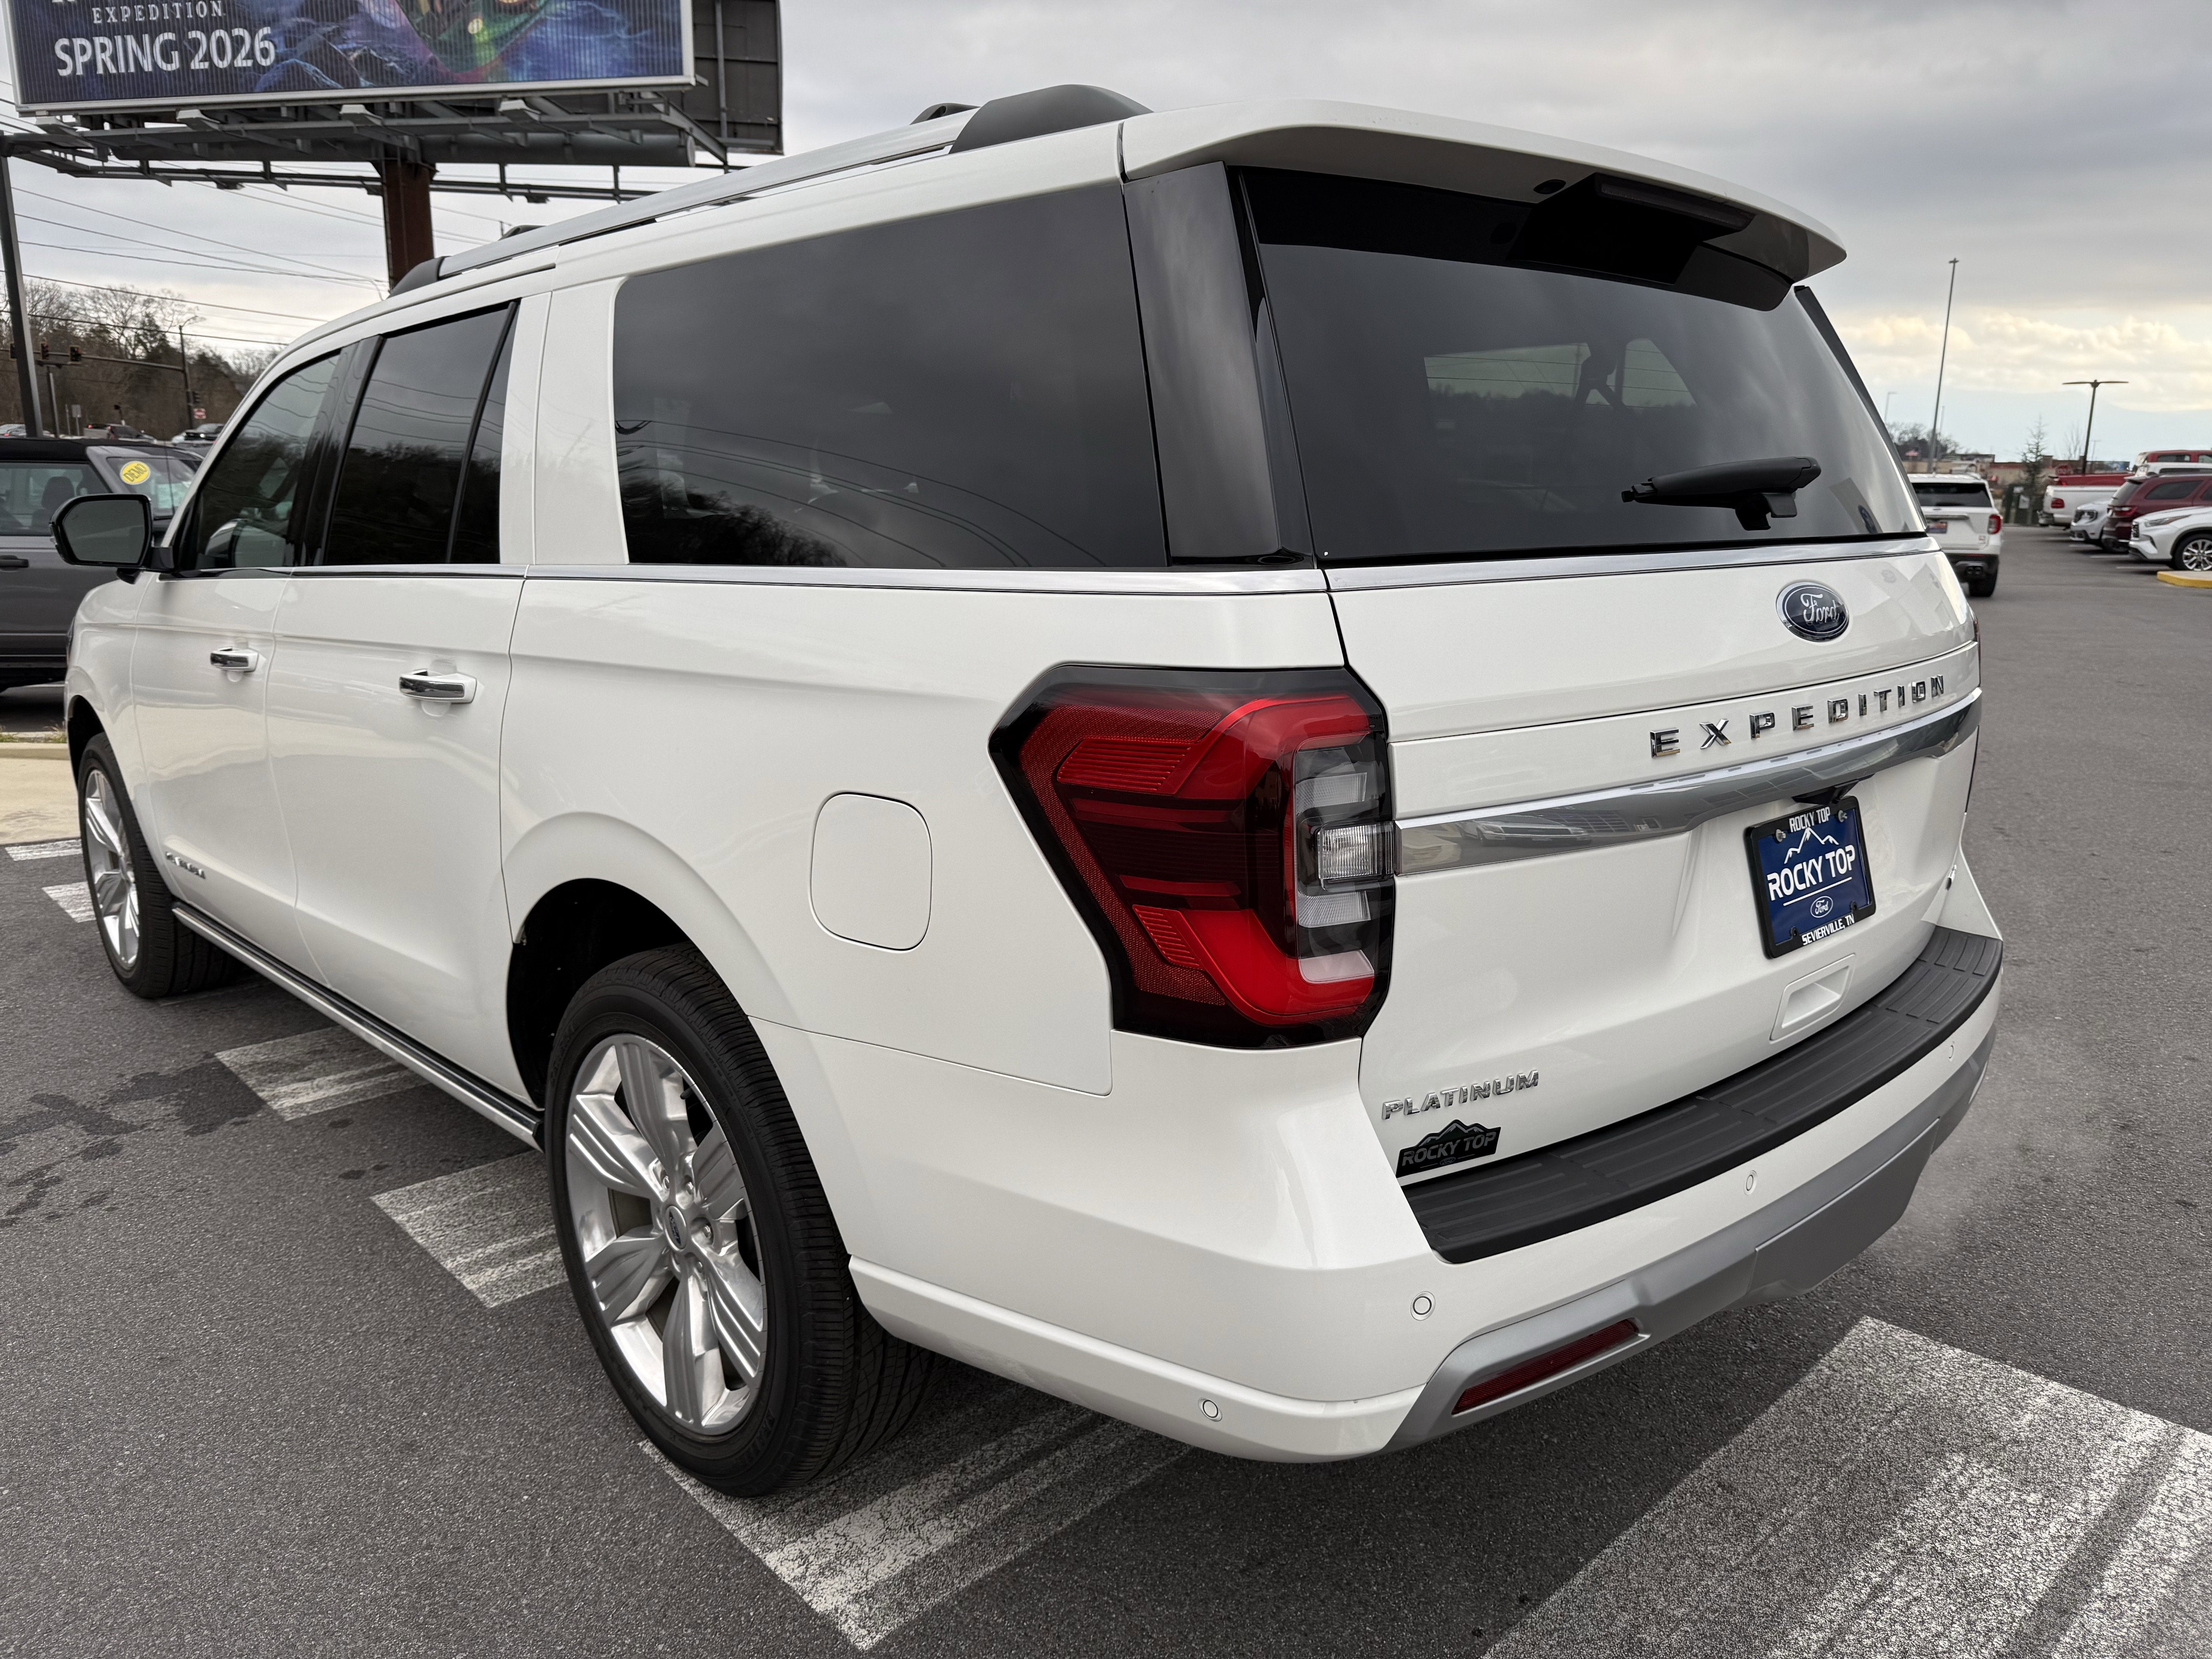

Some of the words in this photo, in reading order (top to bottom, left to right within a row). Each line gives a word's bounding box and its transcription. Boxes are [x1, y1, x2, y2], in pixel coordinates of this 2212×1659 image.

[92, 0, 223, 24] EXPEDITION
[55, 32, 181, 77] SPRING
[187, 26, 276, 70] 2026
[123, 464, 148, 482] DEMO
[1800, 593, 1839, 625] Ford
[1650, 674, 1944, 758] EXPEDITION
[1789, 811, 1815, 832] ROCKY
[1815, 806, 1831, 823] TOP
[1767, 855, 1822, 901] ROCKY
[1825, 845, 1856, 878] TOP
[1815, 899, 1829, 915] Ford
[1802, 919, 1845, 945] SEVIERVILLE,
[1845, 913, 1855, 926] TN
[1382, 1070, 1539, 1120] PLATINUM
[1401, 1139, 1461, 1166] ROCKY
[1463, 1131, 1497, 1151] TOP
